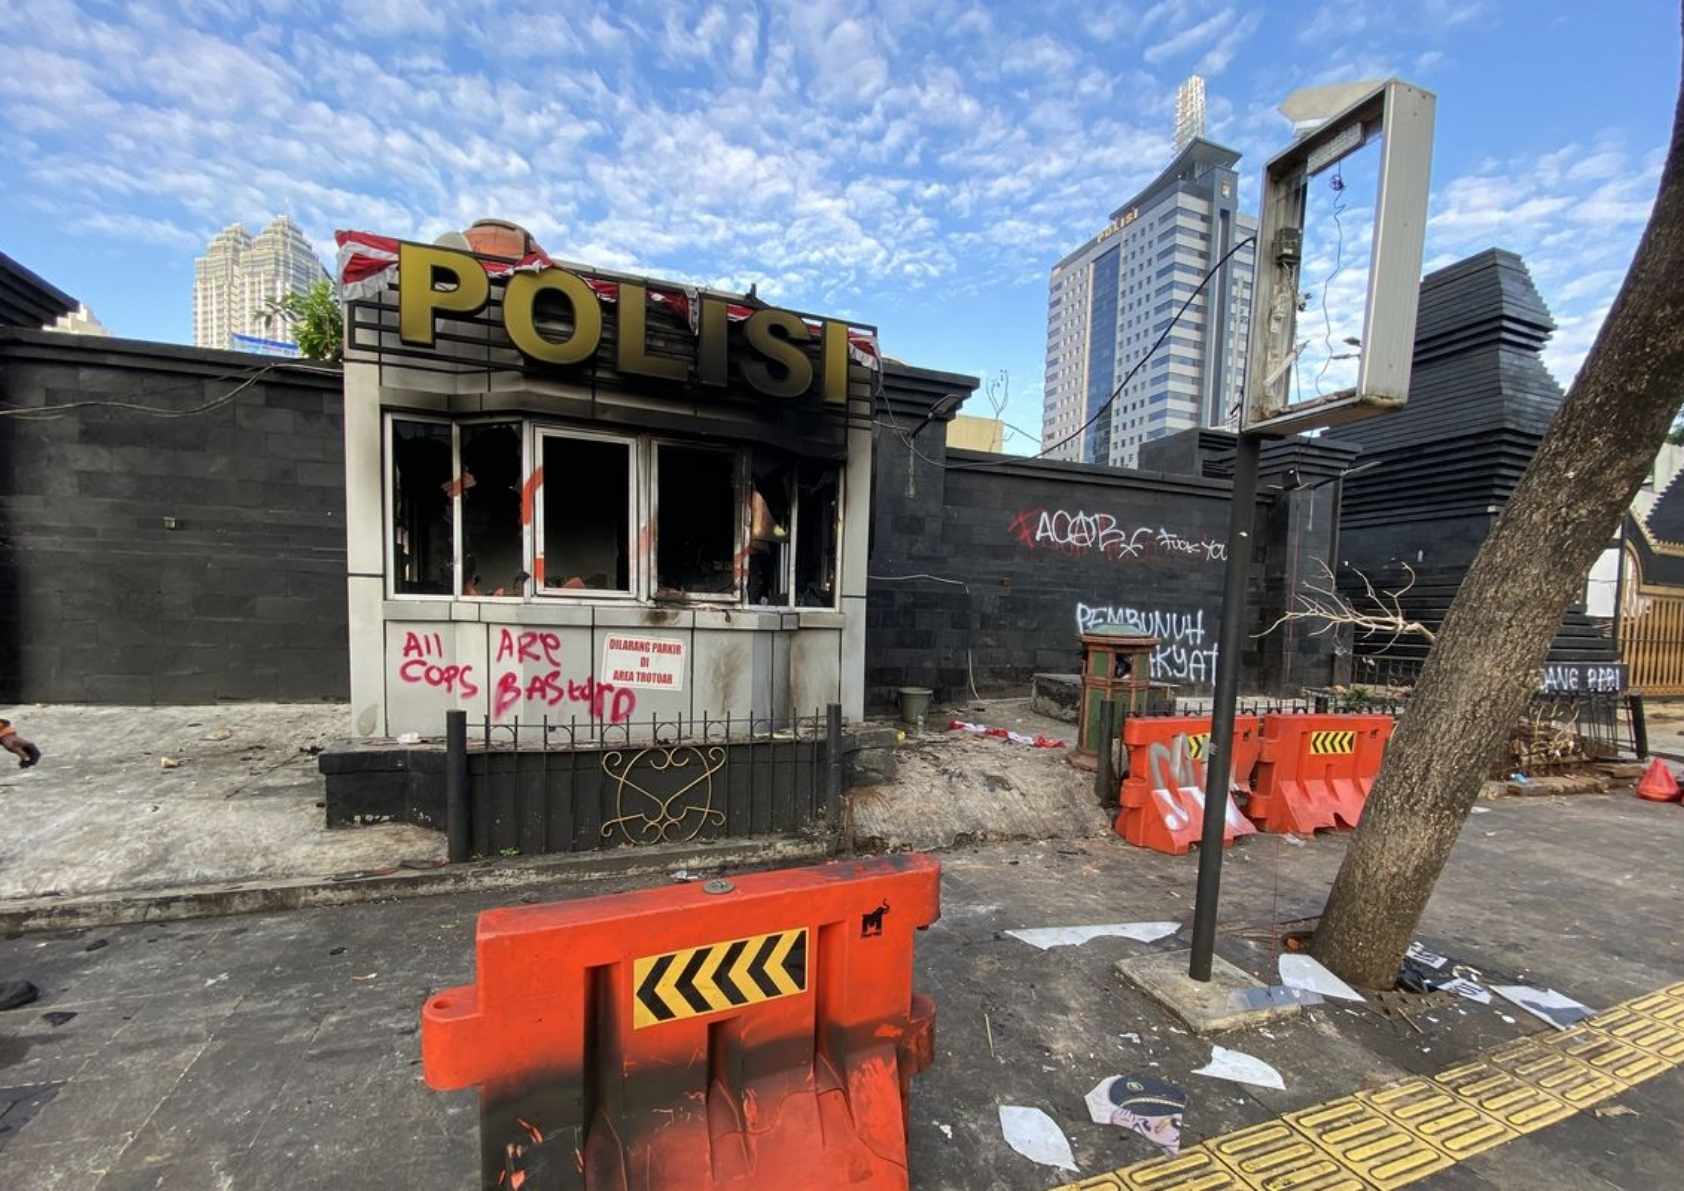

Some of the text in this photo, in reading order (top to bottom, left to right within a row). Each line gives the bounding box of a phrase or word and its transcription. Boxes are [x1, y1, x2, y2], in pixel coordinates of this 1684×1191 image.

[400, 243, 849, 401] POLISI
[1035, 510, 1125, 551] ACAB
[609, 639, 682, 655] DILARANG PARKIR
[640, 656, 650, 668] DI
[400, 659, 479, 699] COPS
[613, 670, 673, 684] AREA TROTOAR
